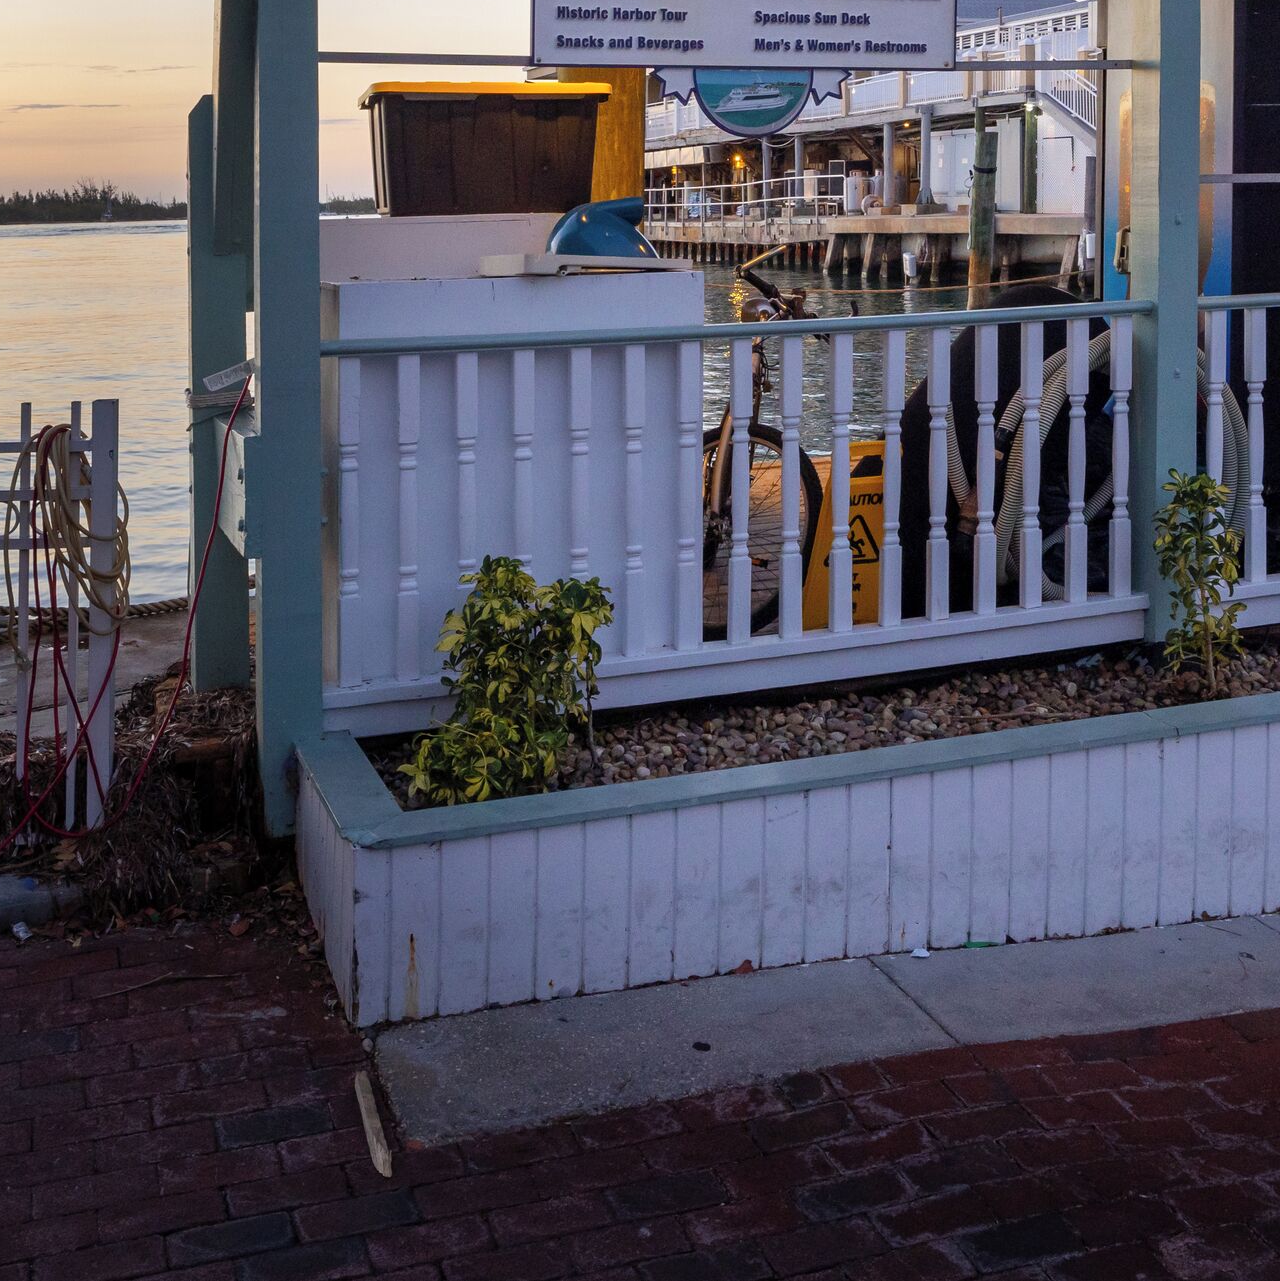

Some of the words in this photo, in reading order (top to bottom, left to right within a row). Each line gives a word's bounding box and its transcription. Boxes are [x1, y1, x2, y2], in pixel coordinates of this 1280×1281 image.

[557, 6, 608, 20] Historic
[613, 7, 657, 21] Harbor
[661, 8, 688, 22] Tour
[755, 11, 811, 25] Spacious
[815, 11, 837, 25] Sun
[841, 13, 870, 25] Deck
[557, 35, 604, 49] Snacks
[609, 36, 632, 49] and
[638, 36, 704, 51] Beverages
[754, 38, 791, 52] Men's
[795, 40, 804, 52] &
[807, 40, 860, 53] Women's
[865, 41, 927, 54] Restrooms
